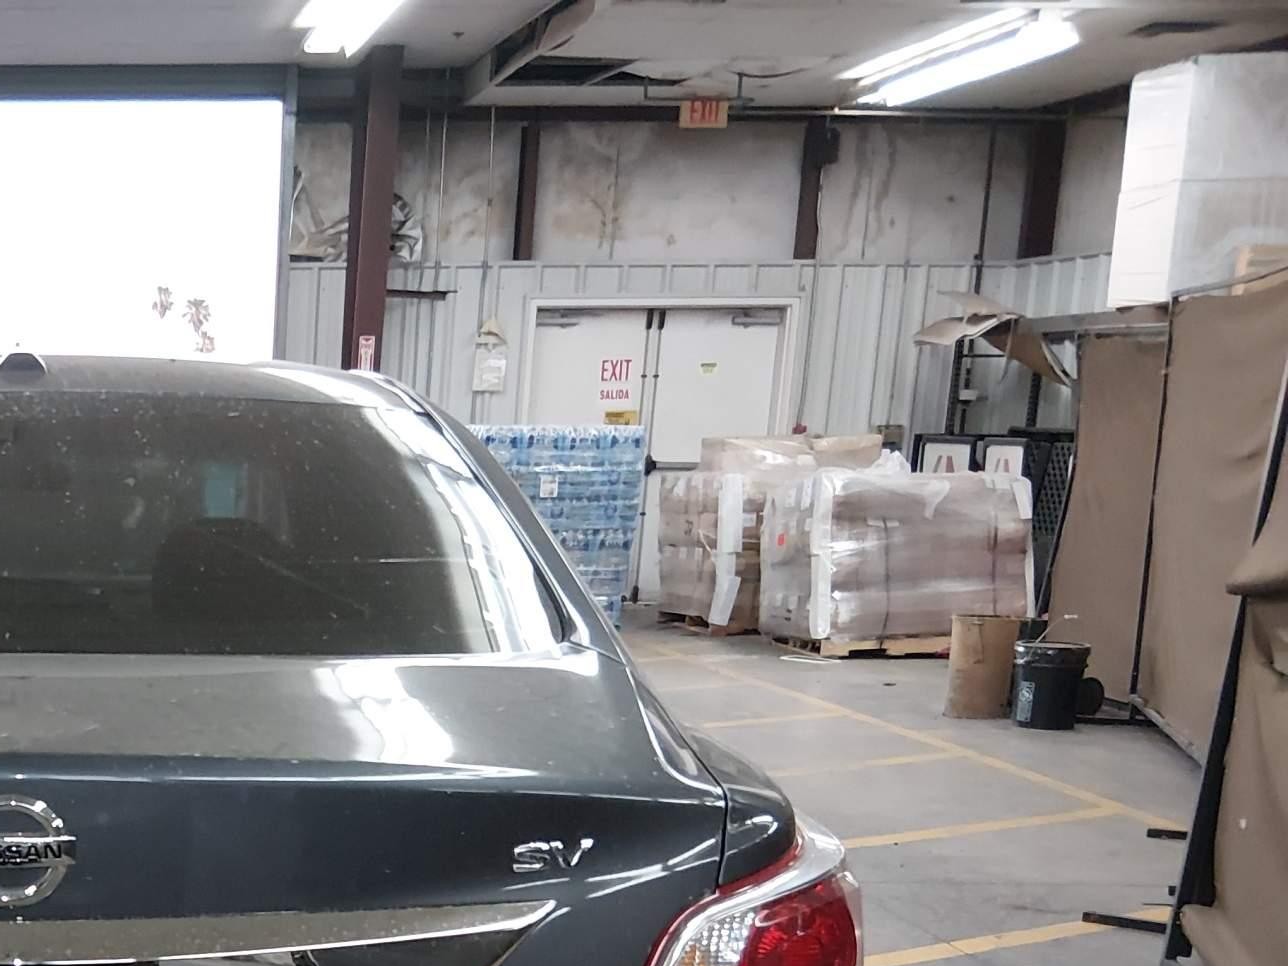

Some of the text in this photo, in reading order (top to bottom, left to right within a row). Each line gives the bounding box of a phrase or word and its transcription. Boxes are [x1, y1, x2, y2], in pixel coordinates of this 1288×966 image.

[690, 100, 720, 122] EXIT
[600, 359, 632, 382] EXIT
[599, 389, 630, 400] SALIDA
[512, 838, 594, 873] SV
